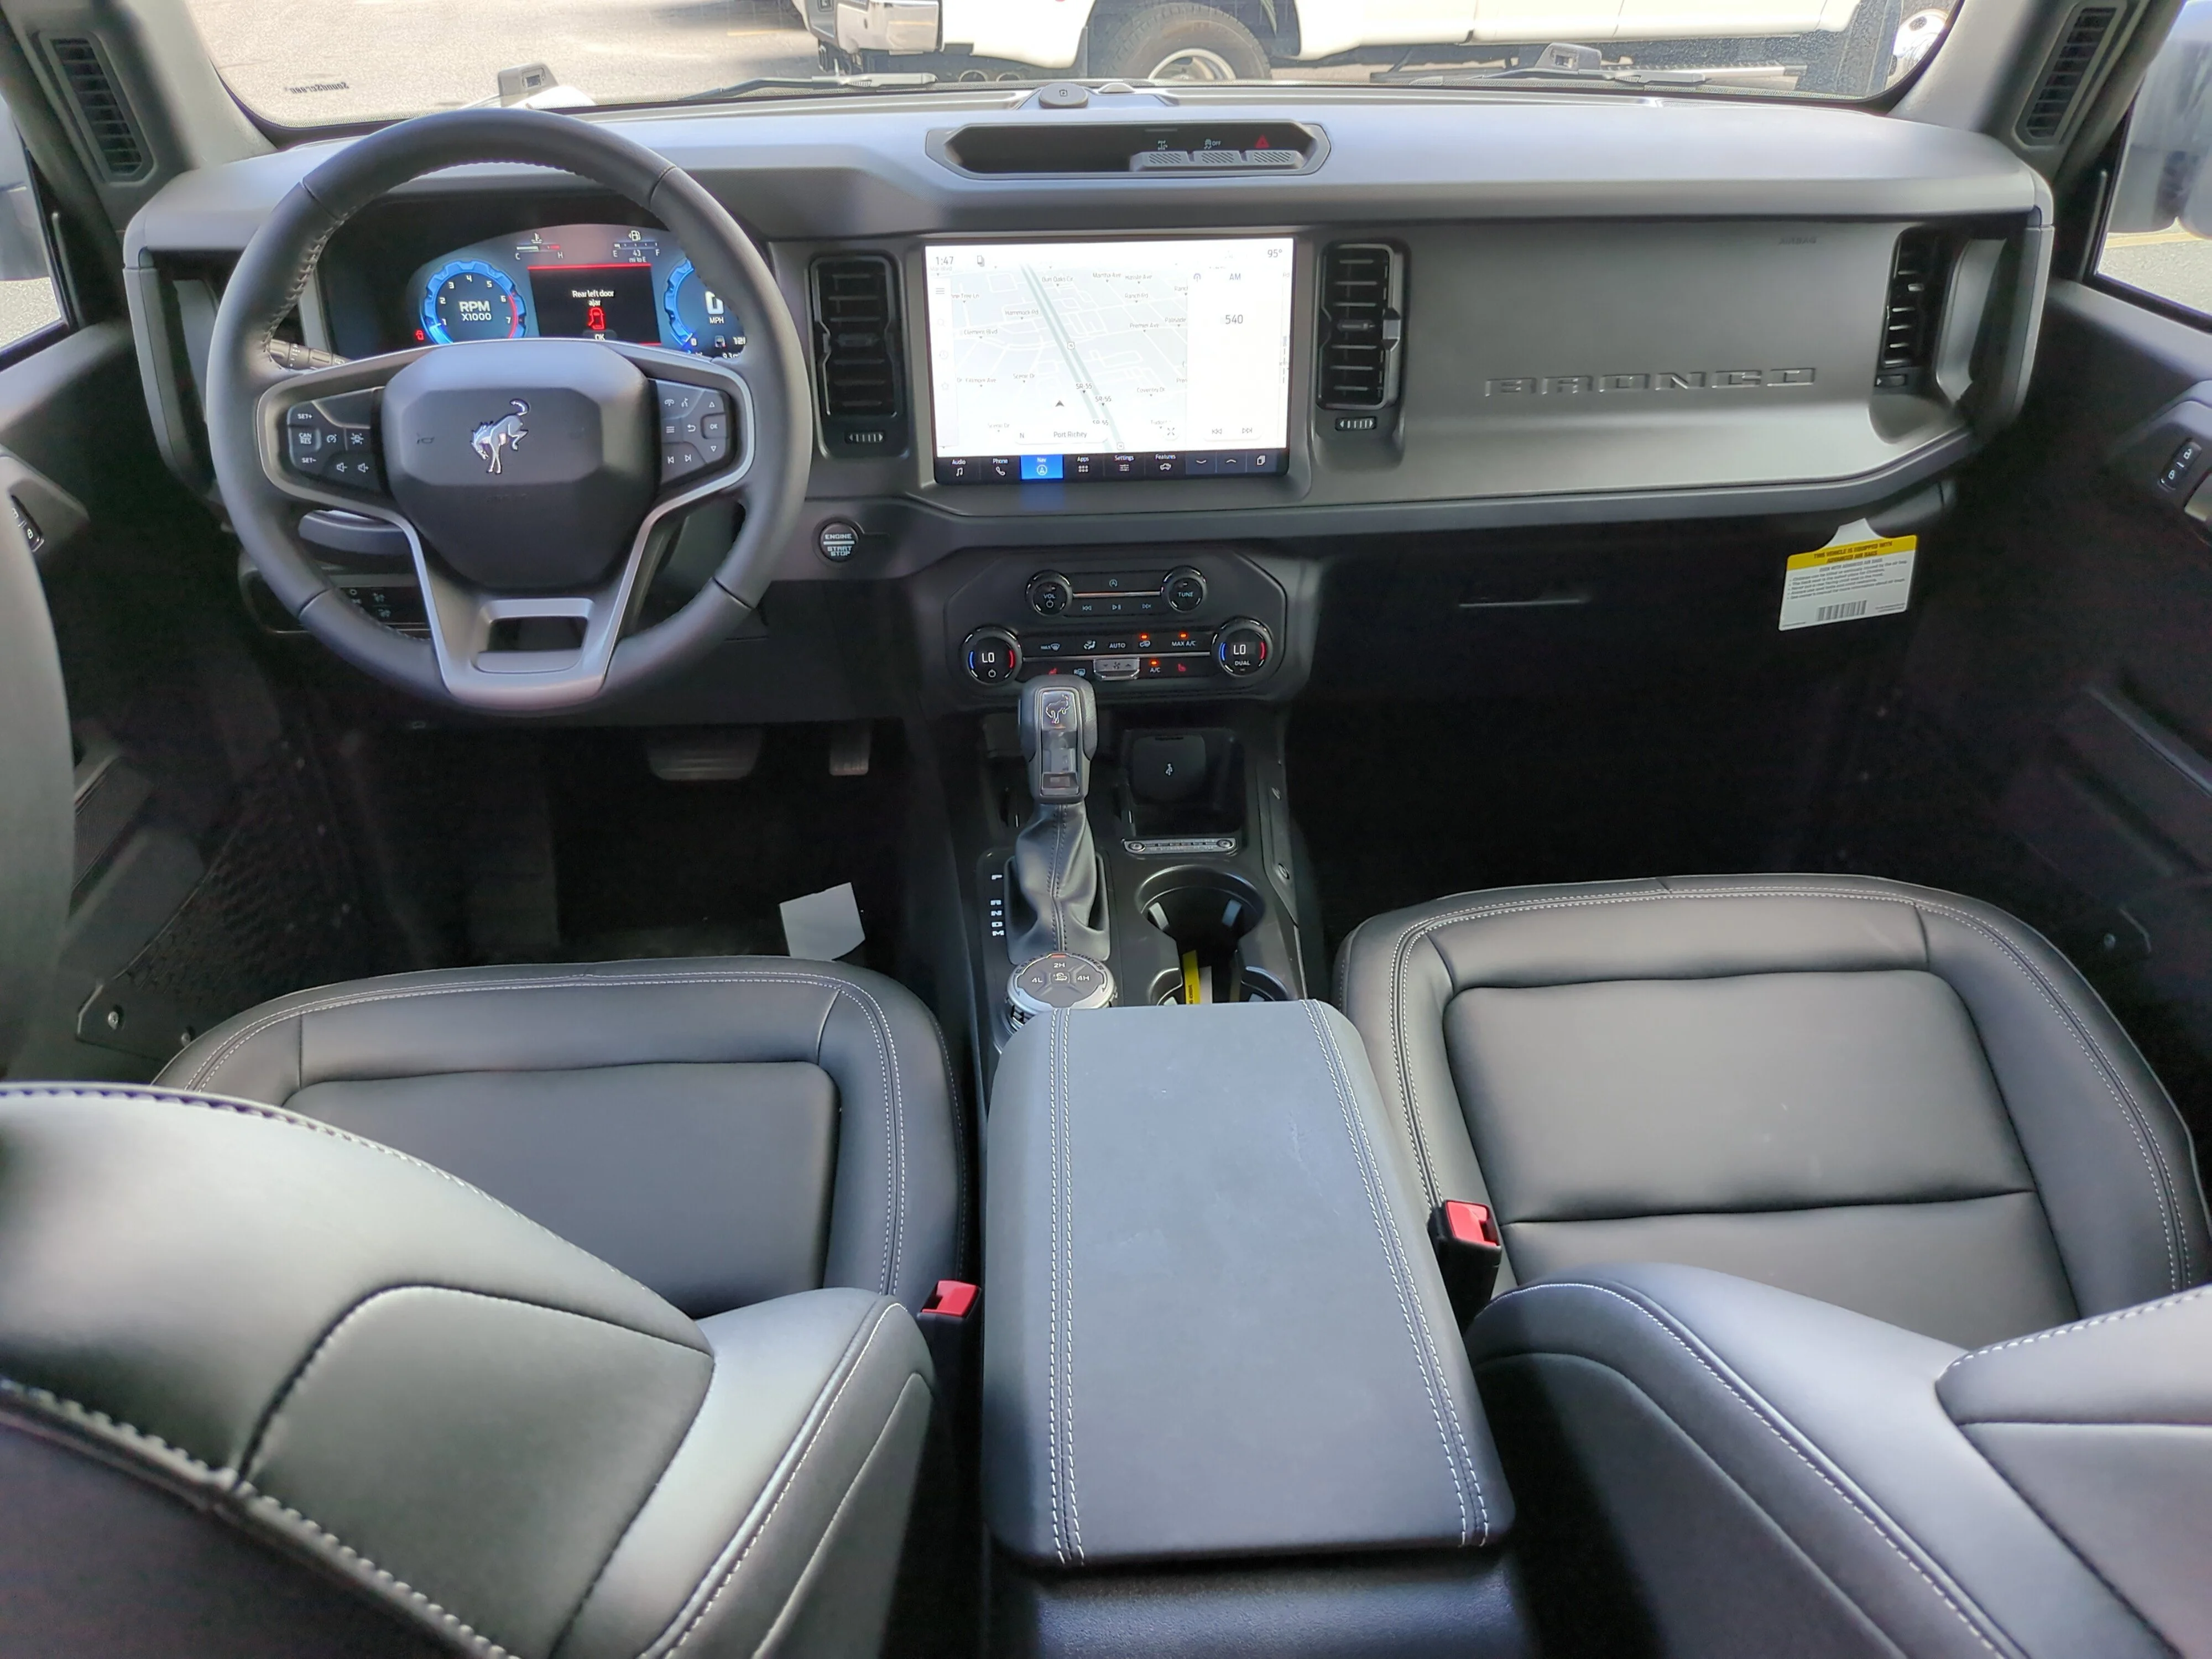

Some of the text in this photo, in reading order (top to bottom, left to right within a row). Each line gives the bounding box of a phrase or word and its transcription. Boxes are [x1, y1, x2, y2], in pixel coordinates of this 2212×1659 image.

[936, 255, 954, 265] 1:47
[1229, 273, 1241, 281] AM
[459, 301, 491, 312] RPM
[461, 312, 492, 321] X1000
[1225, 314, 1244, 325] 540
[1485, 367, 1816, 397] BRONCO
[1233, 644, 1246, 655] LO
[982, 652, 995, 663] LO
